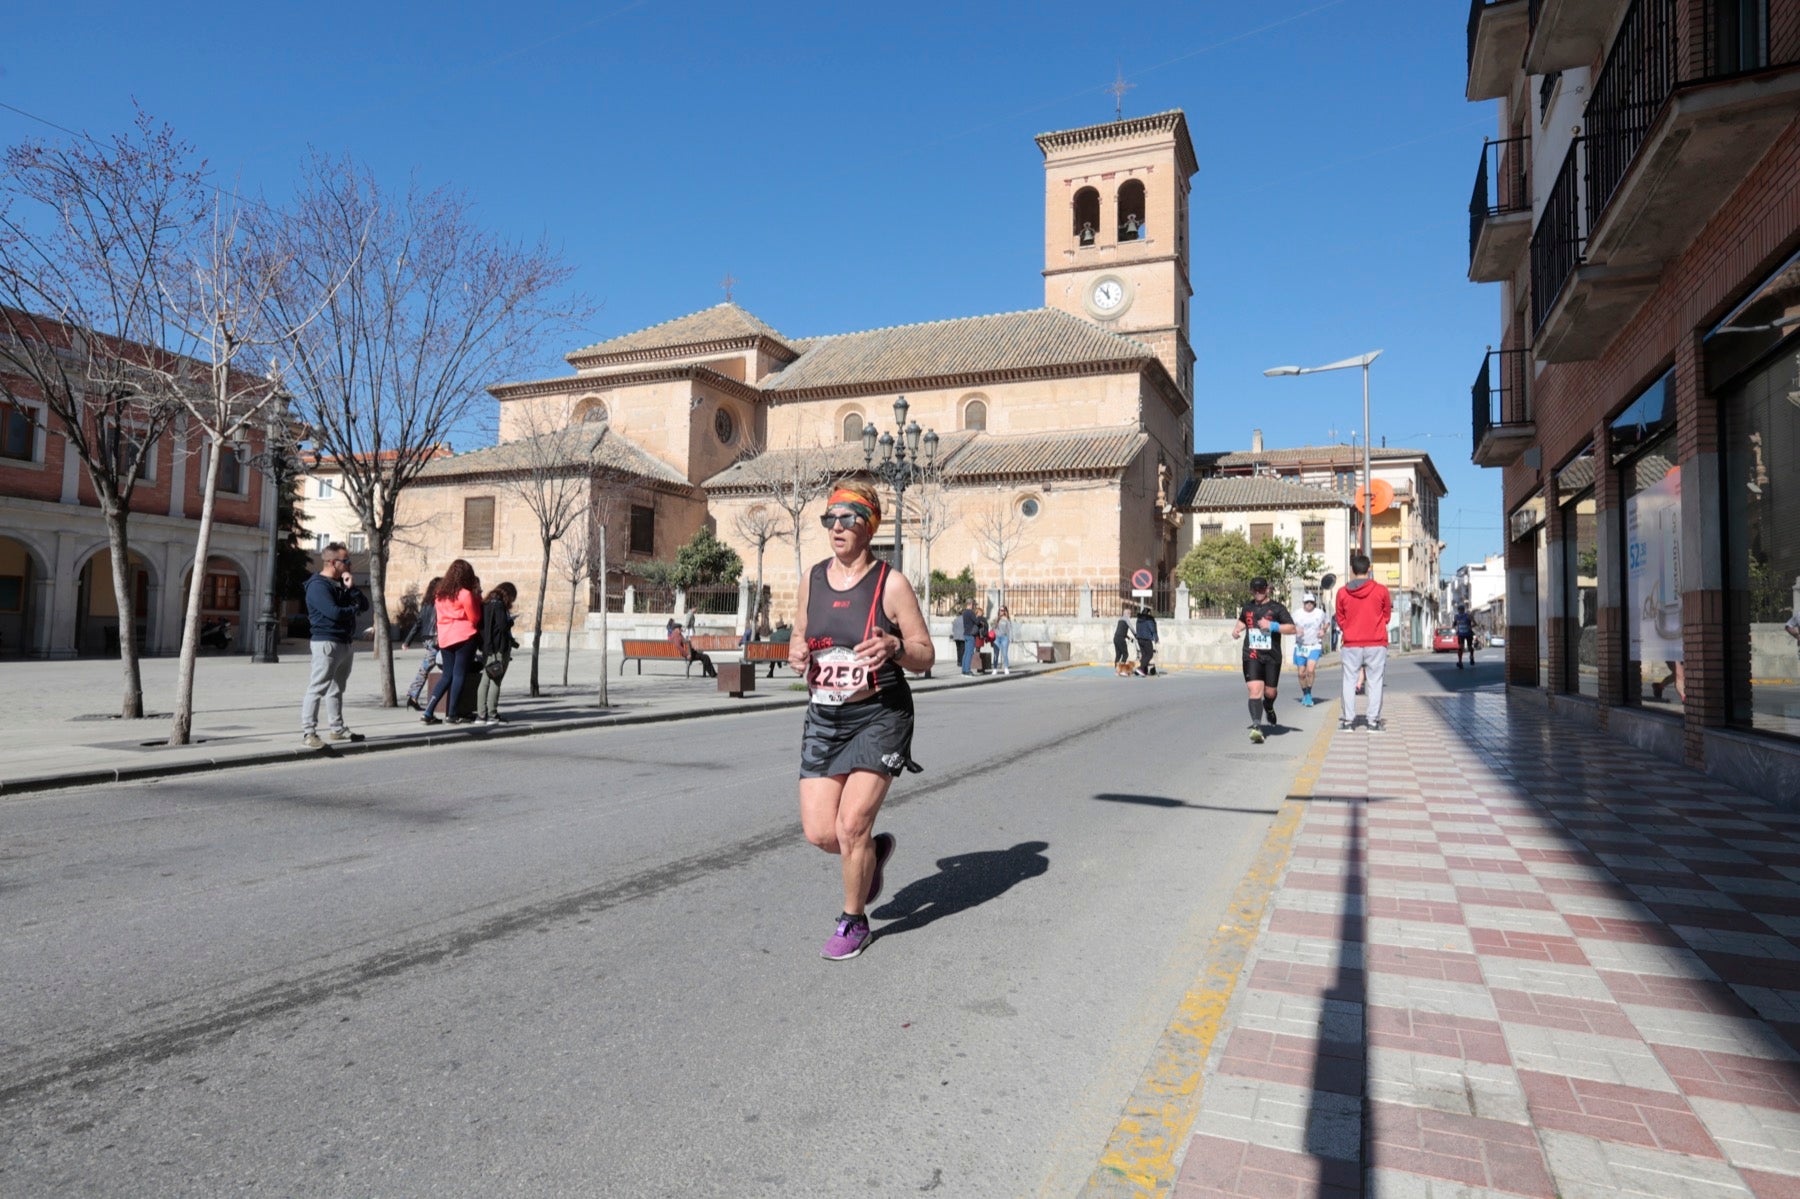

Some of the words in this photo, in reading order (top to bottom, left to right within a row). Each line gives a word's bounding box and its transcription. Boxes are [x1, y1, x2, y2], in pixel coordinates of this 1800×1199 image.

[1630, 543, 1639, 569] 52
[1252, 635, 1267, 643] 144
[811, 666, 864, 687] 2259
